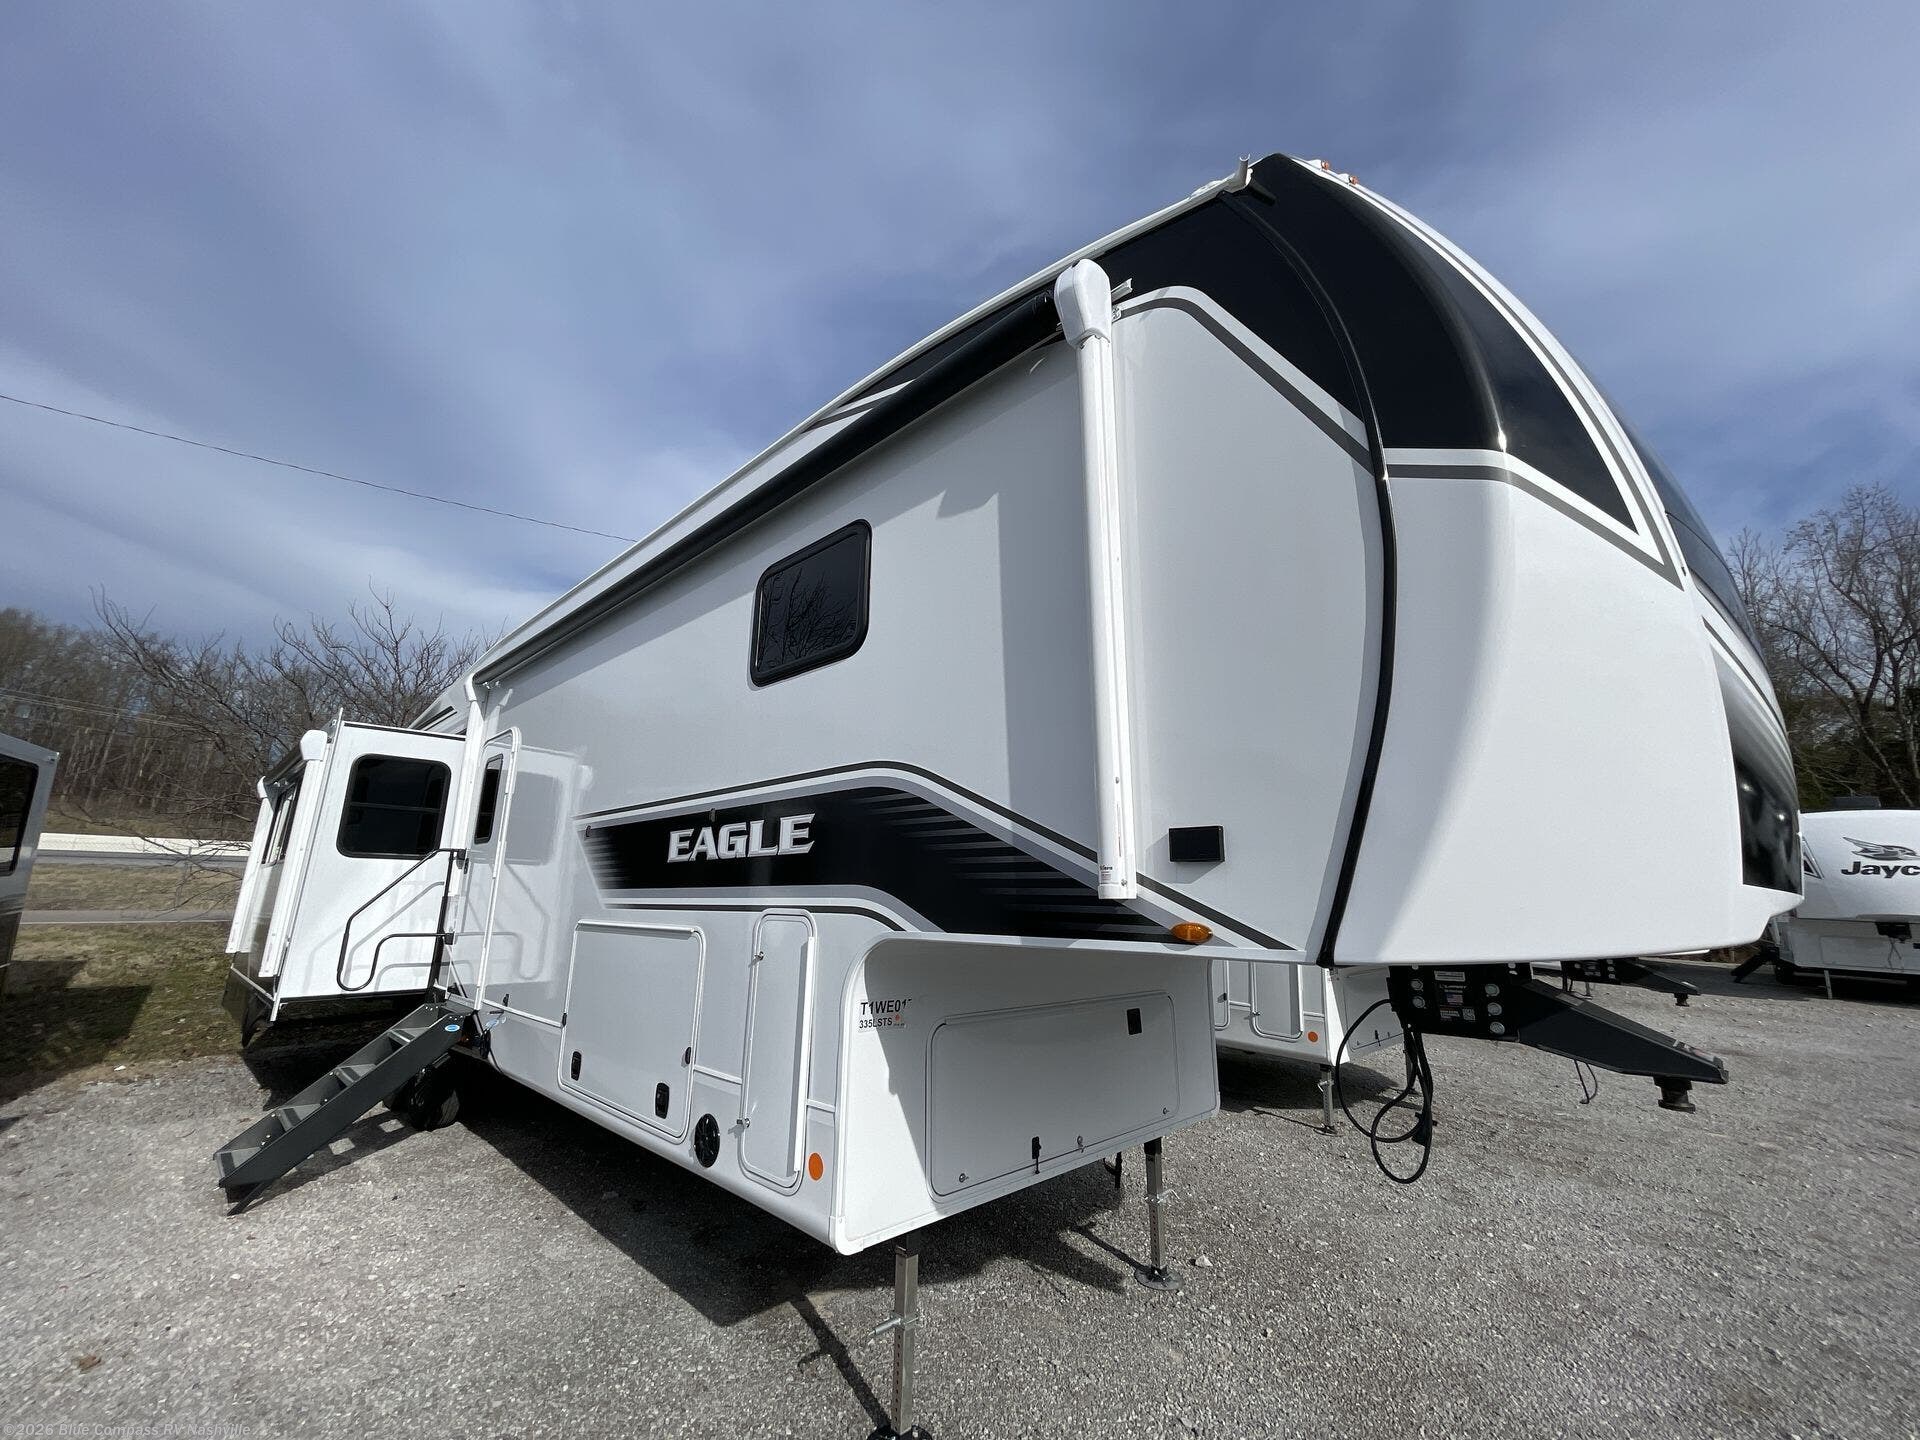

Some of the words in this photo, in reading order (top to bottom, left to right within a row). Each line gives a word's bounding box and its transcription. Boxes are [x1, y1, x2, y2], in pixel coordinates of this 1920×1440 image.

[667, 813, 815, 863] EAGLE
[861, 999, 912, 1015] T1WE01
[859, 1017, 893, 1029] 335LSTS
